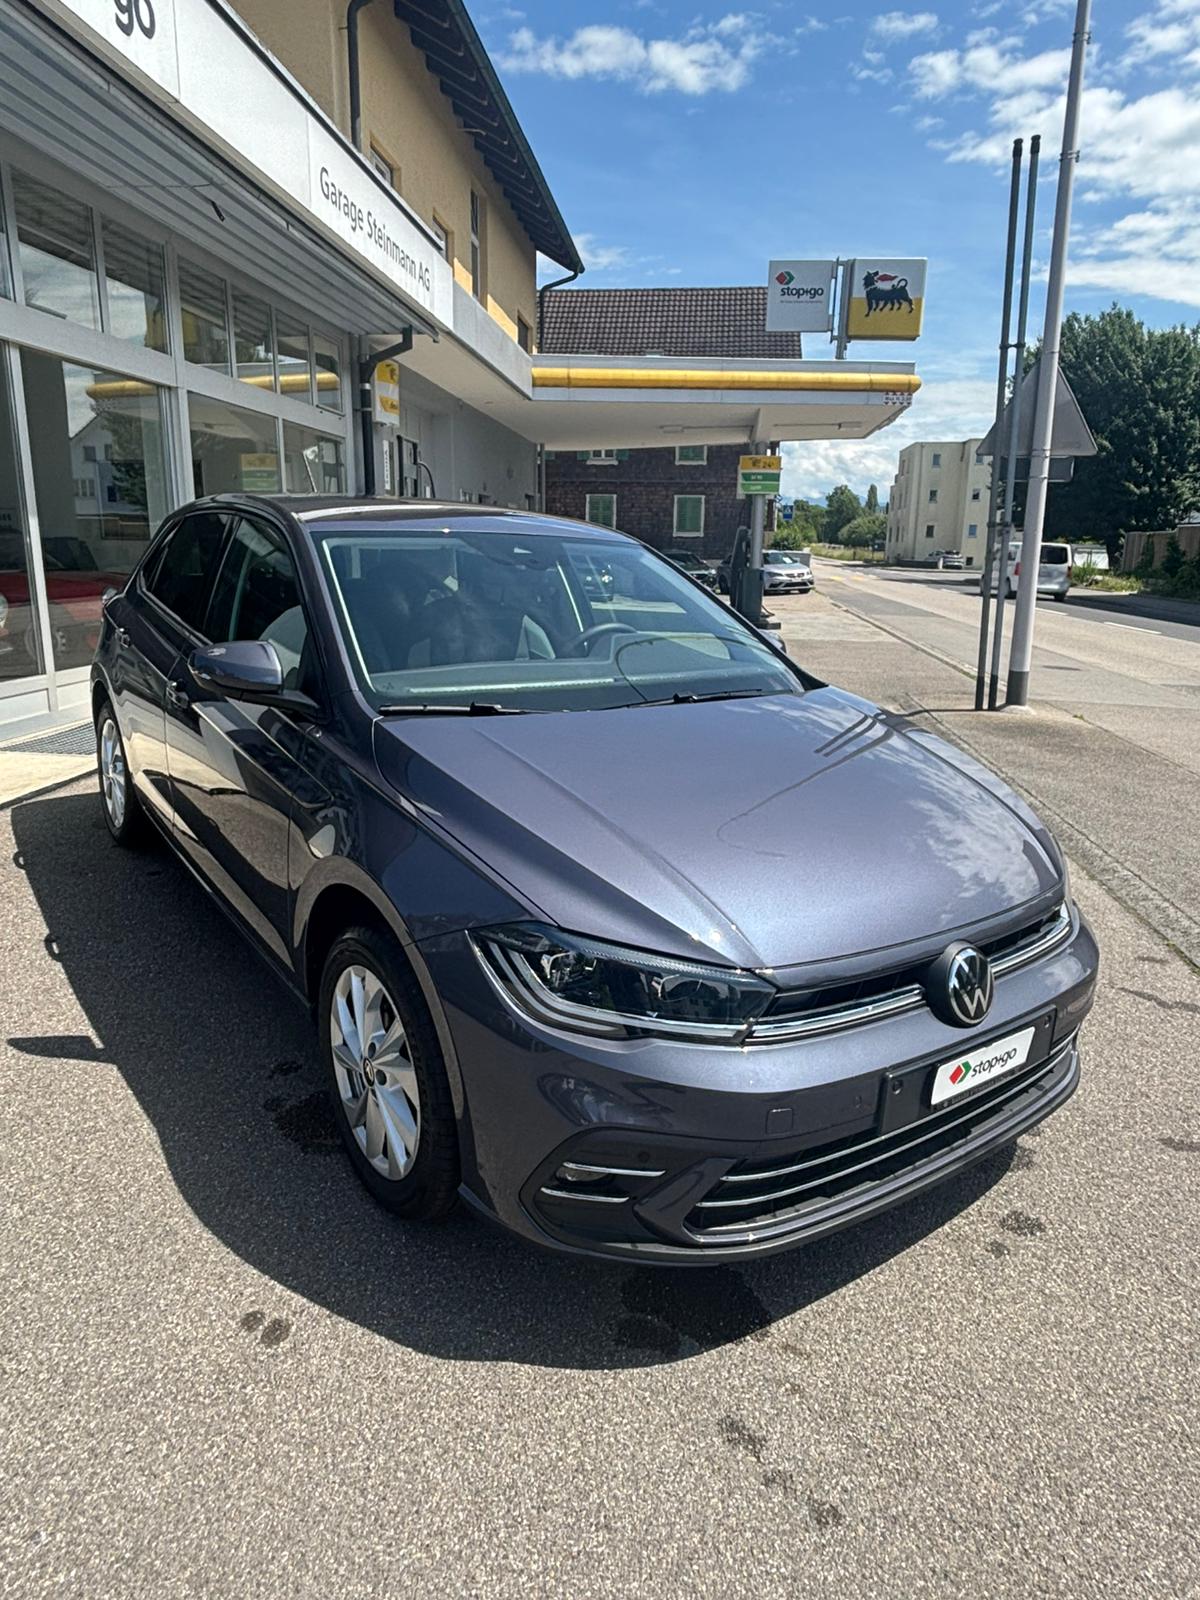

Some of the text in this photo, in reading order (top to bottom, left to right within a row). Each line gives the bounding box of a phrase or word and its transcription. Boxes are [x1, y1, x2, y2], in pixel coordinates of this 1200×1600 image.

[320, 166, 431, 292] Garage Steinmann AG
[780, 286, 824, 299] stop+go
[971, 1047, 1017, 1078] stop+go
